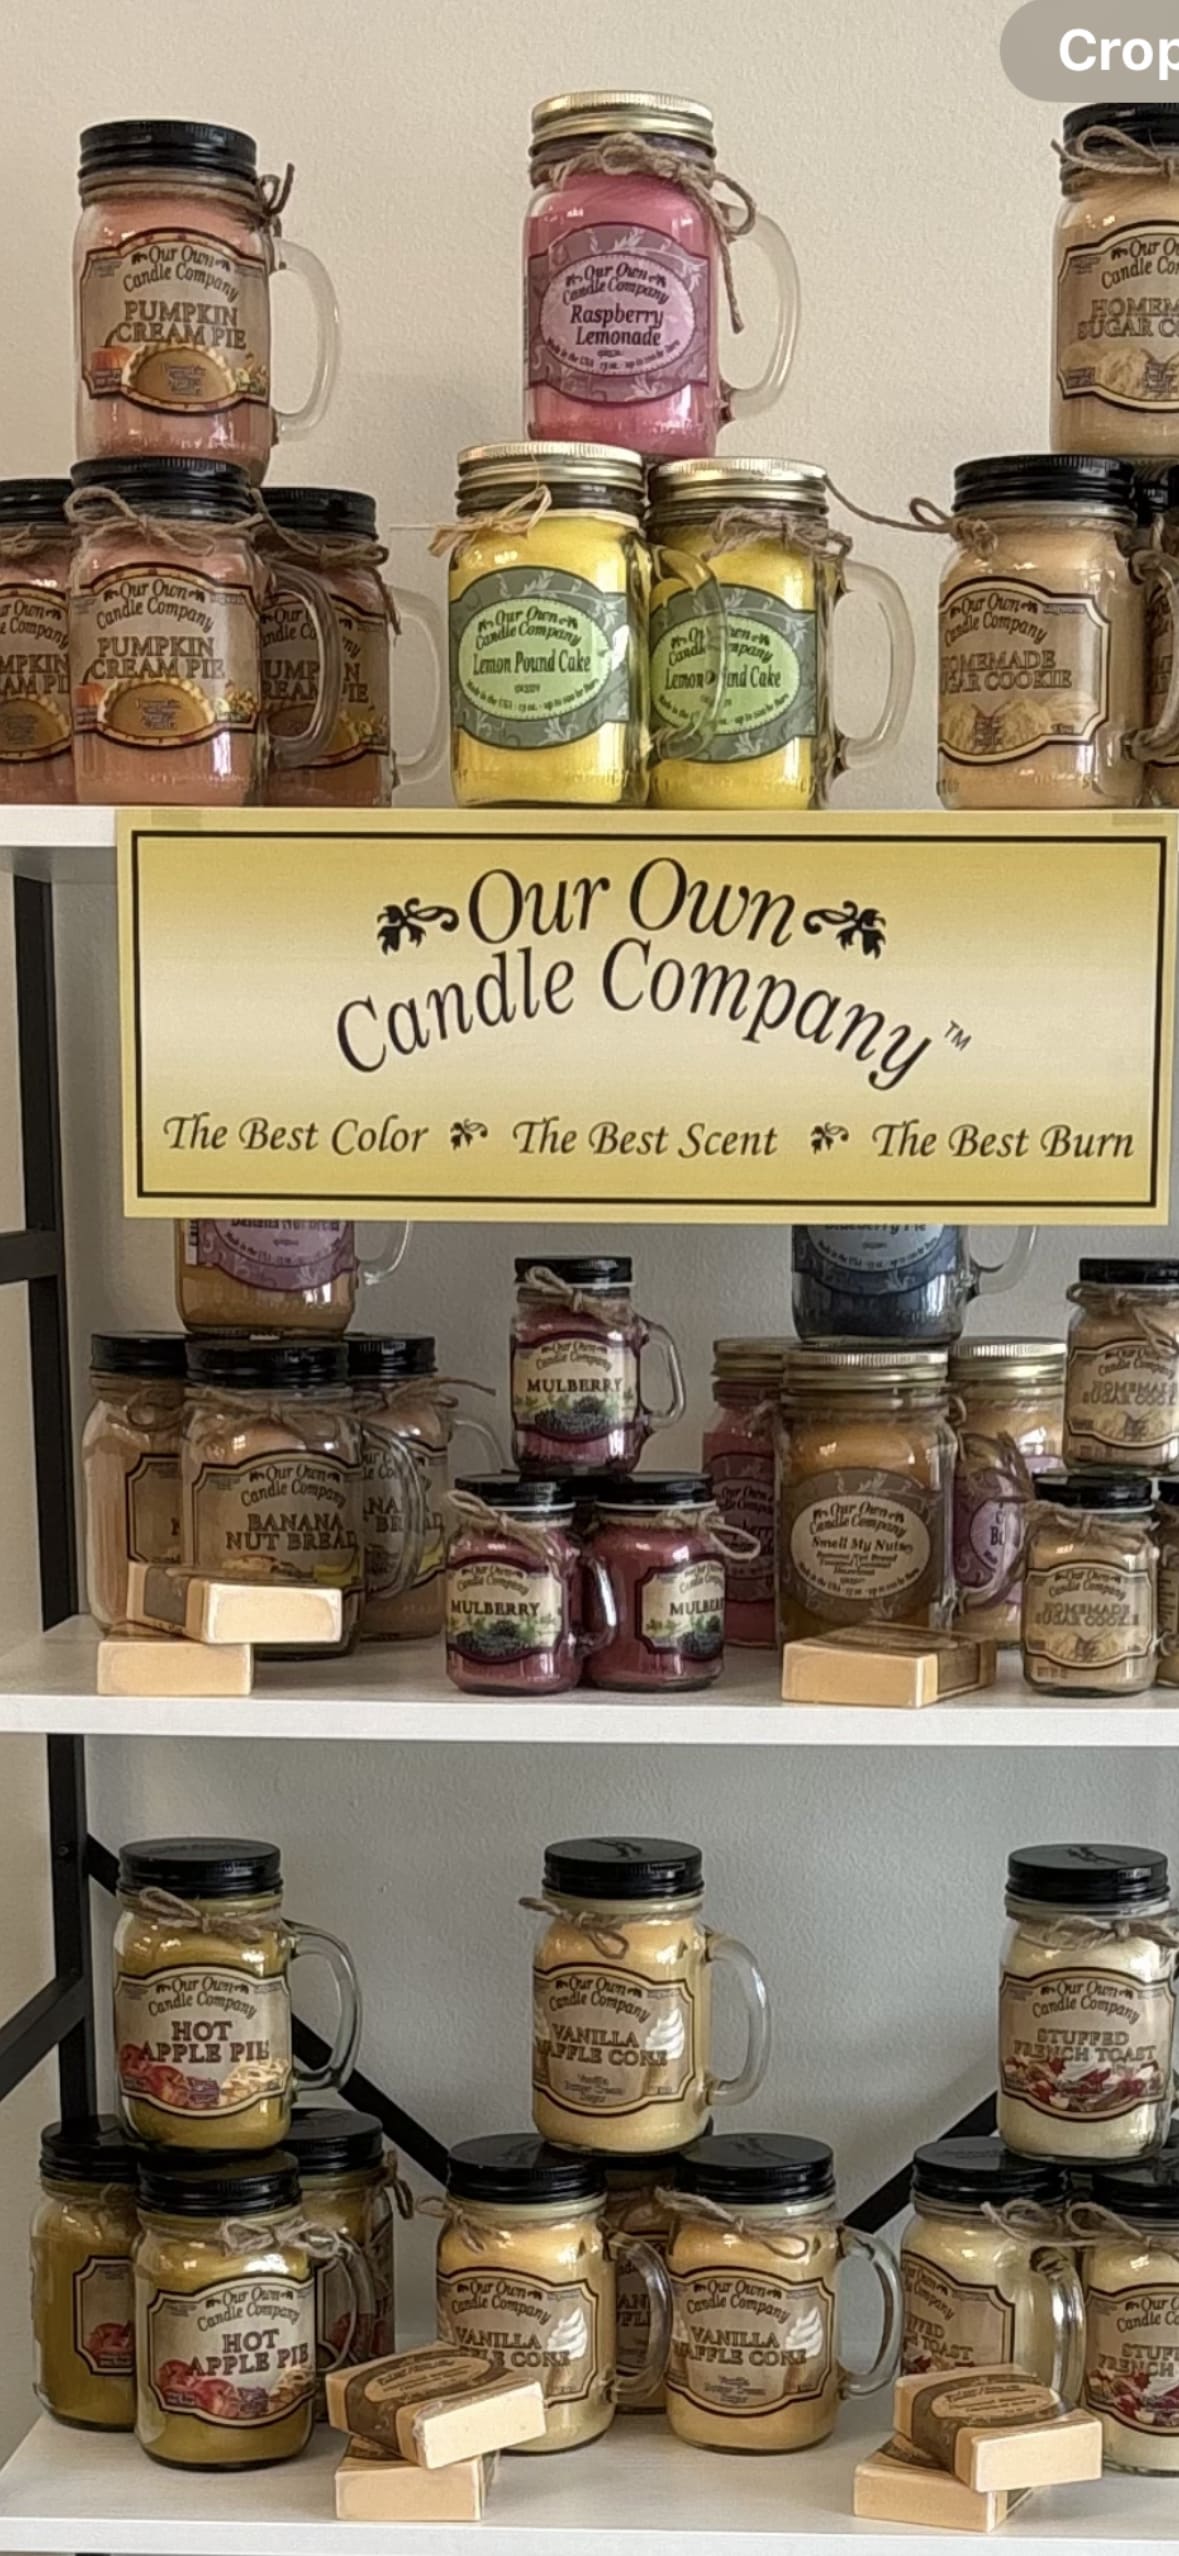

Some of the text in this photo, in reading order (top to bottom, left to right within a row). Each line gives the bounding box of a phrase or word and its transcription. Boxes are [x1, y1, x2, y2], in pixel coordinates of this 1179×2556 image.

[149, 245, 215, 267] Our Own
[1130, 237, 1161, 258] Our
[123, 262, 240, 303] Candle Company
[584, 262, 648, 281] Our Own
[1101, 256, 1153, 290] Candle
[562, 276, 670, 305] Candle Company
[124, 299, 238, 327] PUMPKIN
[570, 302, 664, 330] Raspberry
[1091, 297, 1179, 318] HOMEM
[116, 321, 247, 350] CREAM PIE
[575, 325, 662, 346] Lemonade
[1077, 317, 1154, 341] SUGAR
[120, 578, 188, 600] Our Own
[14, 599, 43, 619] Own
[960, 592, 1022, 614] Our Own
[96, 596, 214, 634] Candle Company
[495, 605, 558, 627] Our Own
[10, 616, 69, 650] Company
[475, 620, 583, 651] Candle Company
[982, 611, 1048, 645] Company
[97, 635, 215, 658] PUMPKIN
[0, 653, 69, 674] MPKIN
[91, 657, 226, 680] CREAM PIE
[472, 648, 591, 675] Lemon Pound Cake
[665, 663, 781, 690] Lemon Cake
[983, 669, 1073, 692] COOKIE
[468, 856, 797, 948] Our Own
[336, 946, 574, 1073] Candle
[601, 937, 932, 1091] Company
[163, 1111, 429, 1156] The Best Color
[512, 1115, 778, 1159] The Best Scent
[872, 1118, 1135, 1159] The Best Burn
[526, 1378, 623, 1393] MULBERRY
[266, 1464, 326, 1481] Our Own
[241, 1478, 347, 1510] Candle Company
[830, 1501, 888, 1519] Our Own
[247, 1512, 344, 1532] BANANA
[851, 1513, 907, 1539] Company
[225, 1529, 358, 1552] NUT BREAD
[811, 1535, 848, 1550] Smell
[850, 1537, 872, 1552] My
[450, 1600, 540, 1617] MULBERRY
[171, 1975, 233, 1994] Our Own
[568, 1975, 627, 1995] Our Own
[1056, 1979, 1118, 1998] Our Own
[148, 1990, 257, 2020] Candle Company
[549, 1989, 651, 2023] Candle Company
[1032, 1993, 1141, 2026] Candle Company
[171, 2020, 233, 2042] HOT
[551, 2023, 640, 2048] VANILLA
[1037, 2027, 1130, 2047] STUFFED
[139, 2039, 270, 2063] APPLE PIE
[608, 2048, 668, 2067] CONE
[1013, 2039, 1157, 2063] FRENCH TOAST
[222, 2286, 281, 2308] Our Own
[470, 2279, 526, 2298] Our Own
[707, 2279, 767, 2298] Our Own
[491, 2294, 552, 2326] Company
[686, 2294, 792, 2325] Candle Company
[1141, 2296, 1169, 2312] Our
[197, 2302, 300, 2333] Candle Company
[1116, 2311, 1161, 2333] Candle
[222, 2328, 280, 2354] HOT
[455, 2326, 542, 2350] VANILLA
[690, 2325, 780, 2348] VANILLA
[186, 2342, 309, 2377] APPLE PIE
[511, 2350, 570, 2368] CONE
[748, 2348, 807, 2367] CONE
[1121, 2342, 1179, 2361] STUF
